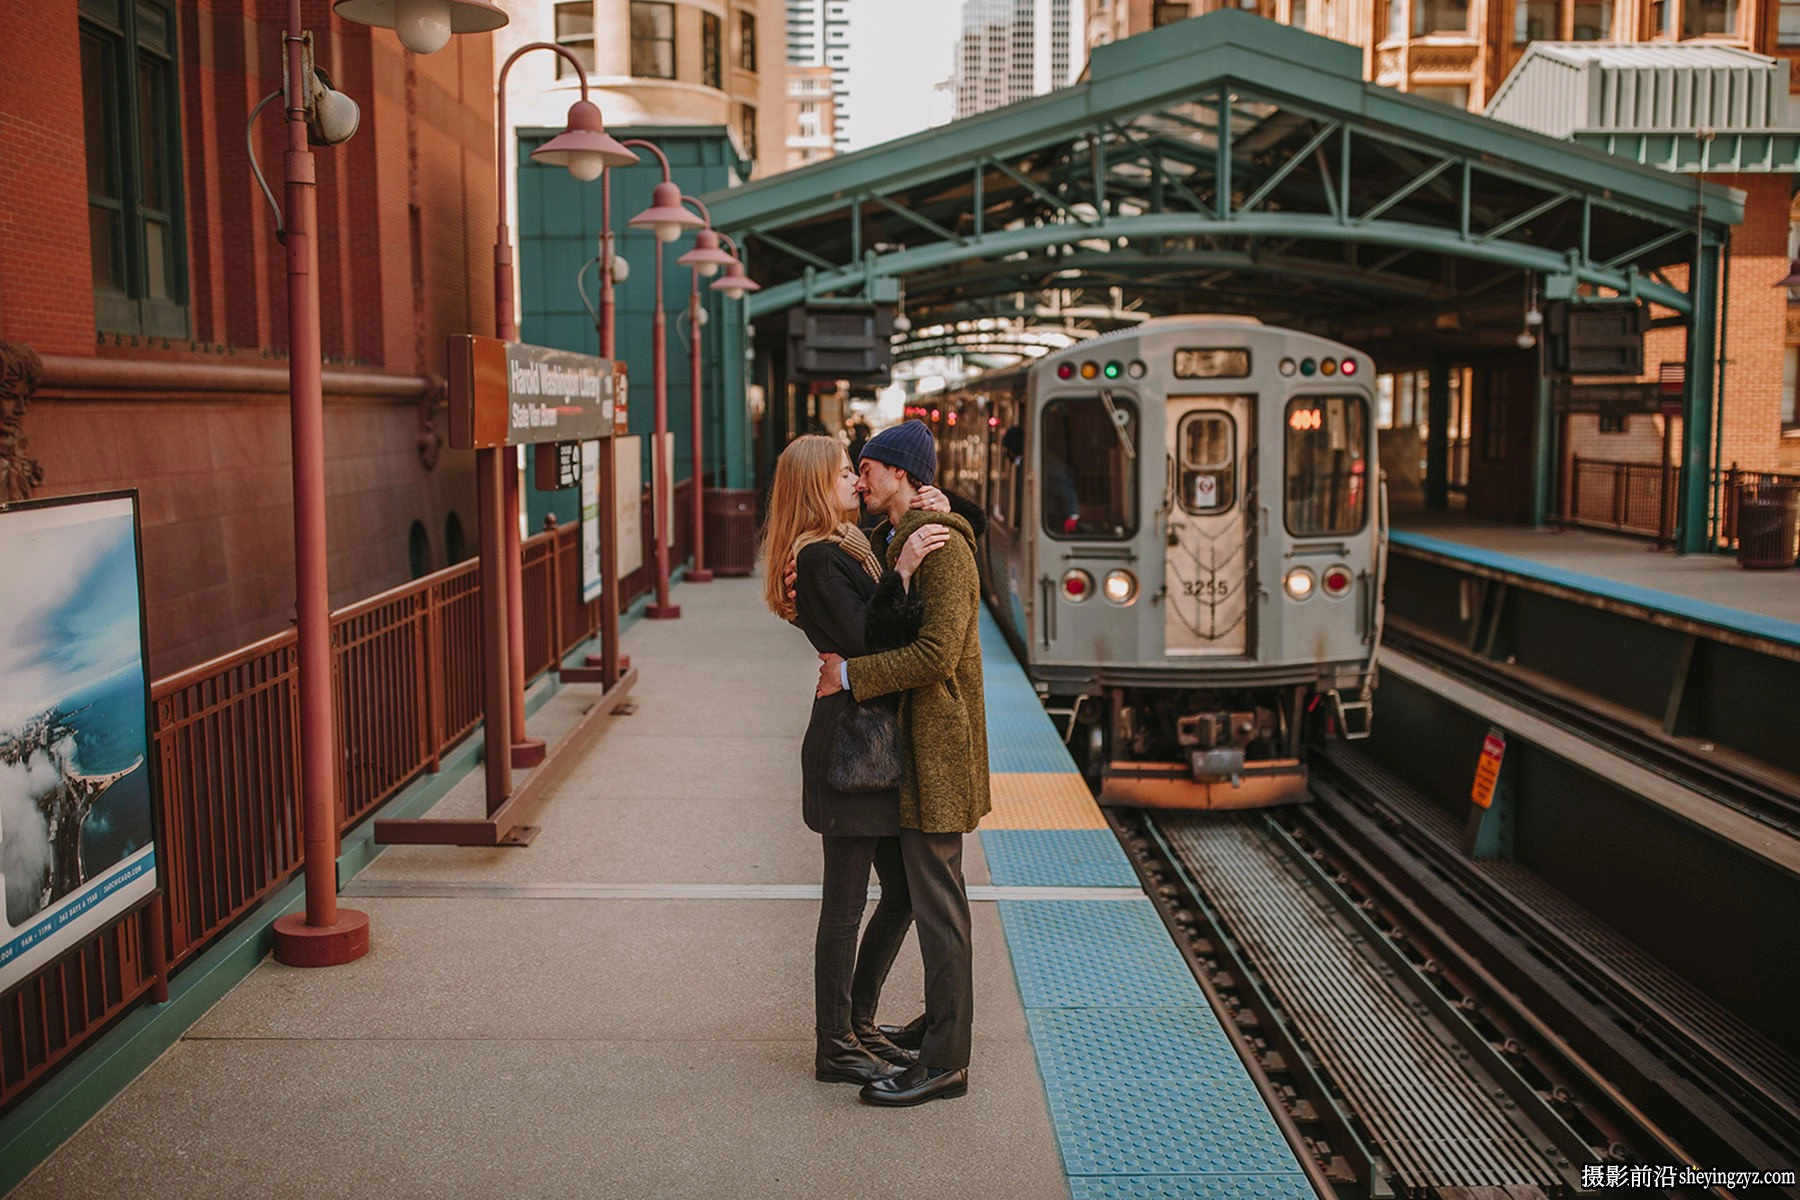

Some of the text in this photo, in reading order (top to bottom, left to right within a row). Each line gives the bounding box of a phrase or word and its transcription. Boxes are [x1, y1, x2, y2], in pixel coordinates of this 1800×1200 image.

[511, 359, 540, 395] Harold
[1183, 580, 1229, 597] 3255
[0, 947, 13, 961] OOR
